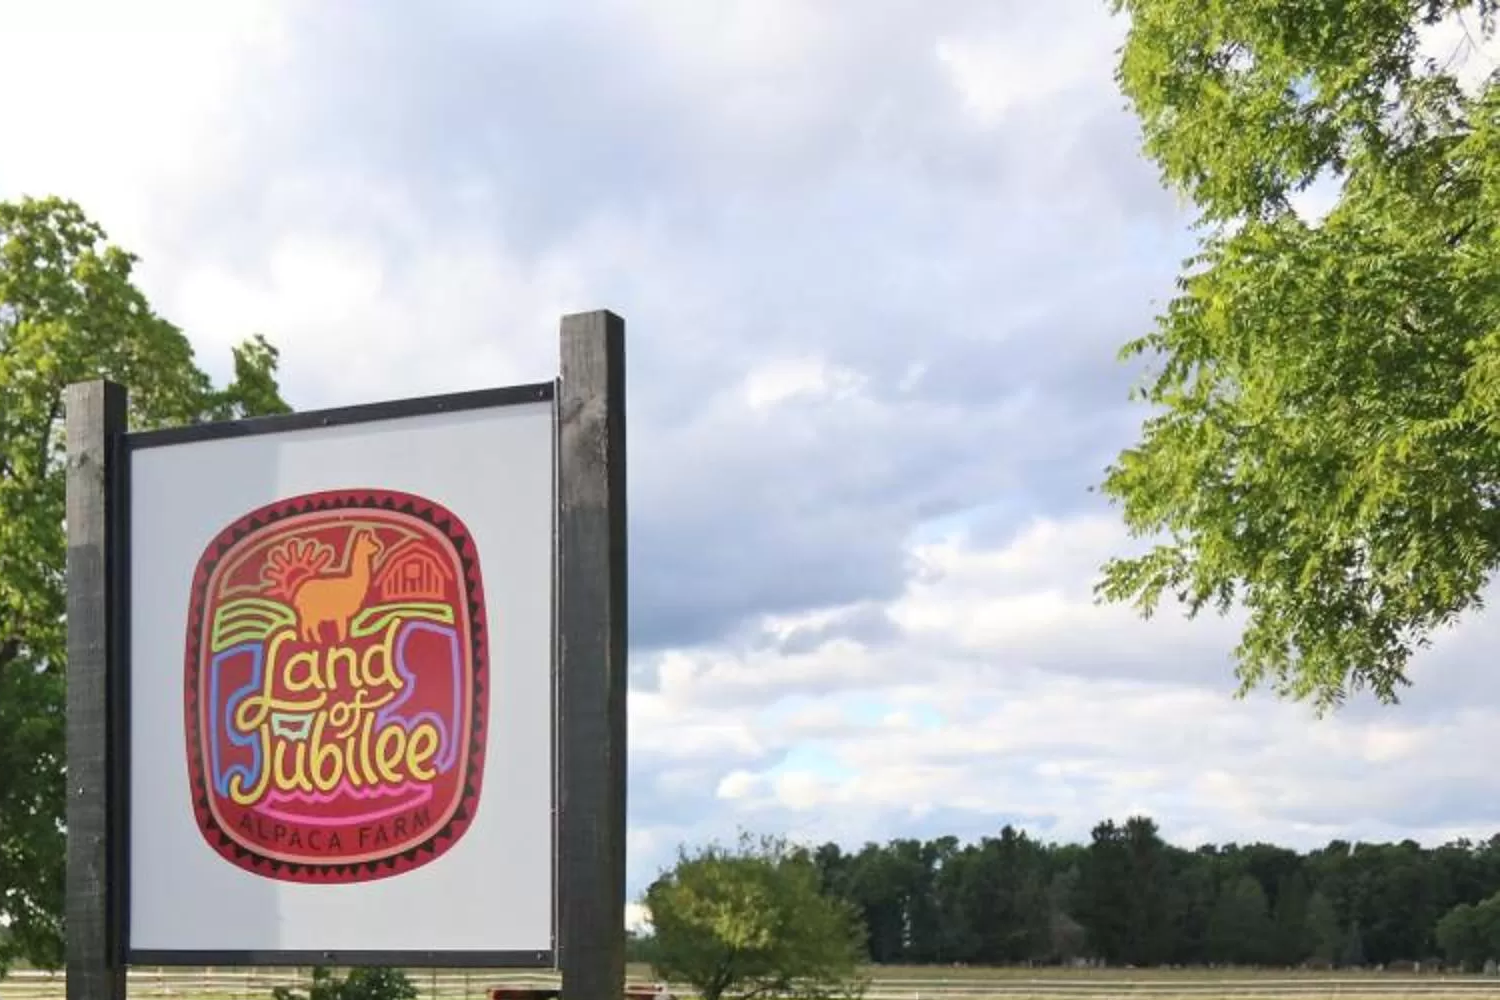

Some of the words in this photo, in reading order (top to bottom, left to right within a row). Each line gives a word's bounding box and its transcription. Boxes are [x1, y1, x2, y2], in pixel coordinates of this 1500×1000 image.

[235, 618, 404, 731] Land
[329, 690, 394, 738] of
[230, 710, 439, 805] Jubilee
[238, 813, 343, 851] ALPACA
[357, 808, 431, 848] FARM
